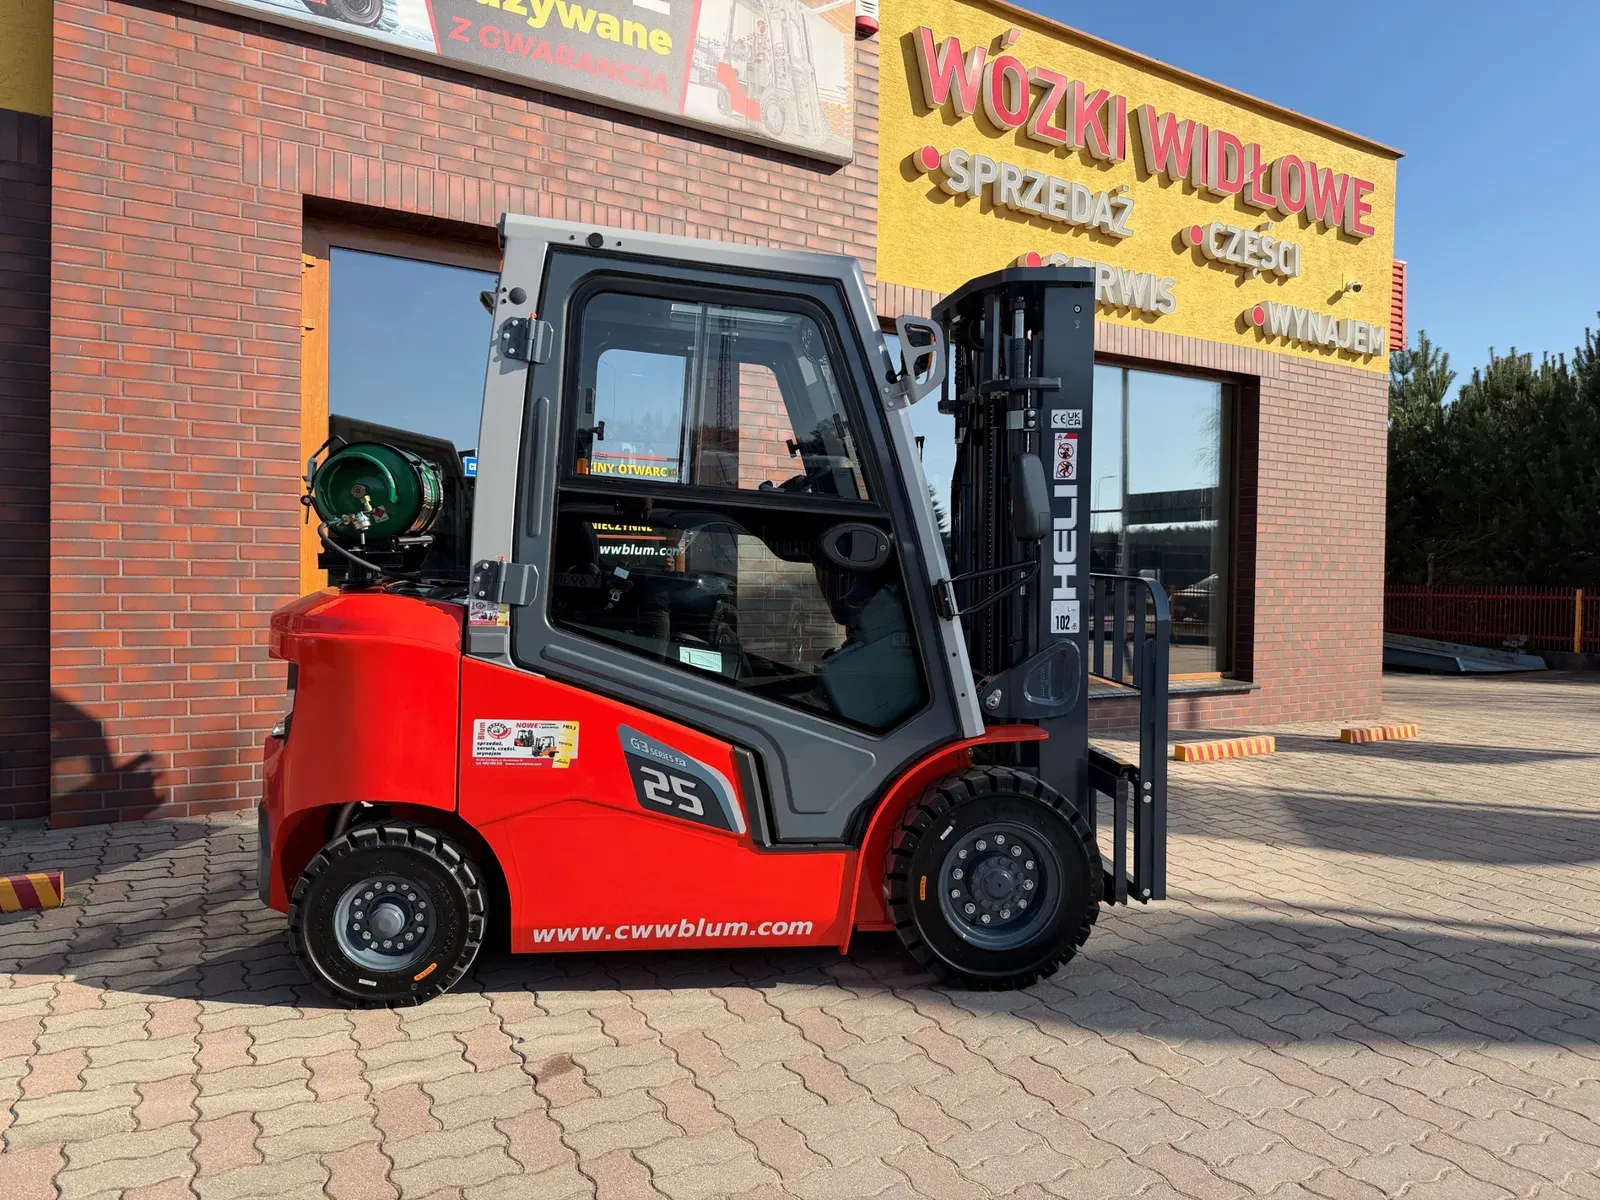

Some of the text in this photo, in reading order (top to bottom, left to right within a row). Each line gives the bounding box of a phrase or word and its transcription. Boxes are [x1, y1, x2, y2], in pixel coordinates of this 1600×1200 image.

[449, 16, 472, 42] Z
[912, 25, 1375, 238] WÓZKI WIDŁOWE
[941, 148, 1135, 239] SPRZEDAŻ
[1202, 221, 1301, 280] CZĘŚCI
[1042, 251, 1176, 316] RWIS
[1264, 300, 1386, 357] WYNAJEM
[590, 462, 615, 472] INY
[1052, 484, 1078, 600] HELI
[1055, 615, 1070, 630] 102
[478, 722, 486, 740] Blum
[630, 738, 674, 762] G3 SERIES
[640, 766, 705, 816] 25
[532, 918, 813, 943] www.cwwblum.com
